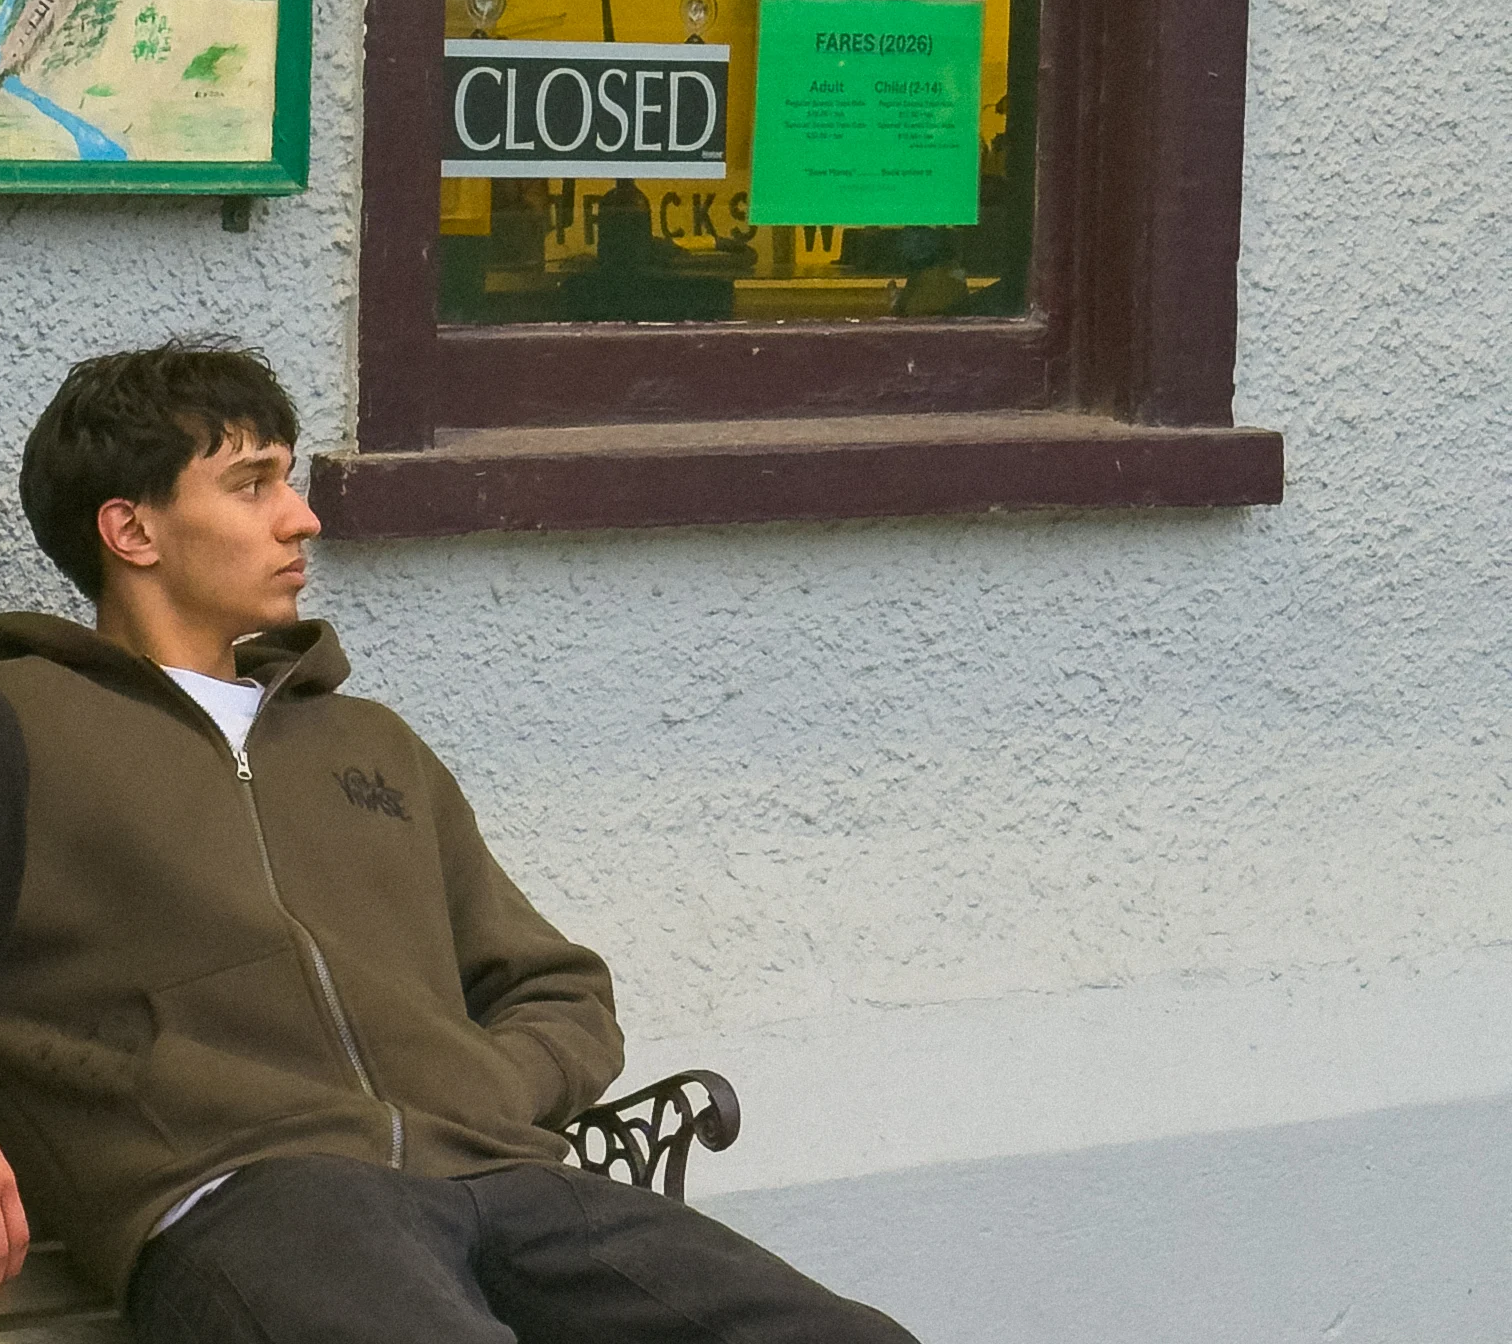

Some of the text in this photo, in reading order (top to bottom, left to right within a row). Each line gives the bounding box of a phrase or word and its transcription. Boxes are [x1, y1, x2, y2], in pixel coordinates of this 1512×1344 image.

[815, 32, 933, 56] FARES (2026)
[809, 80, 942, 97] Adult Child (2-14)
[454, 66, 718, 154] CLOSED
